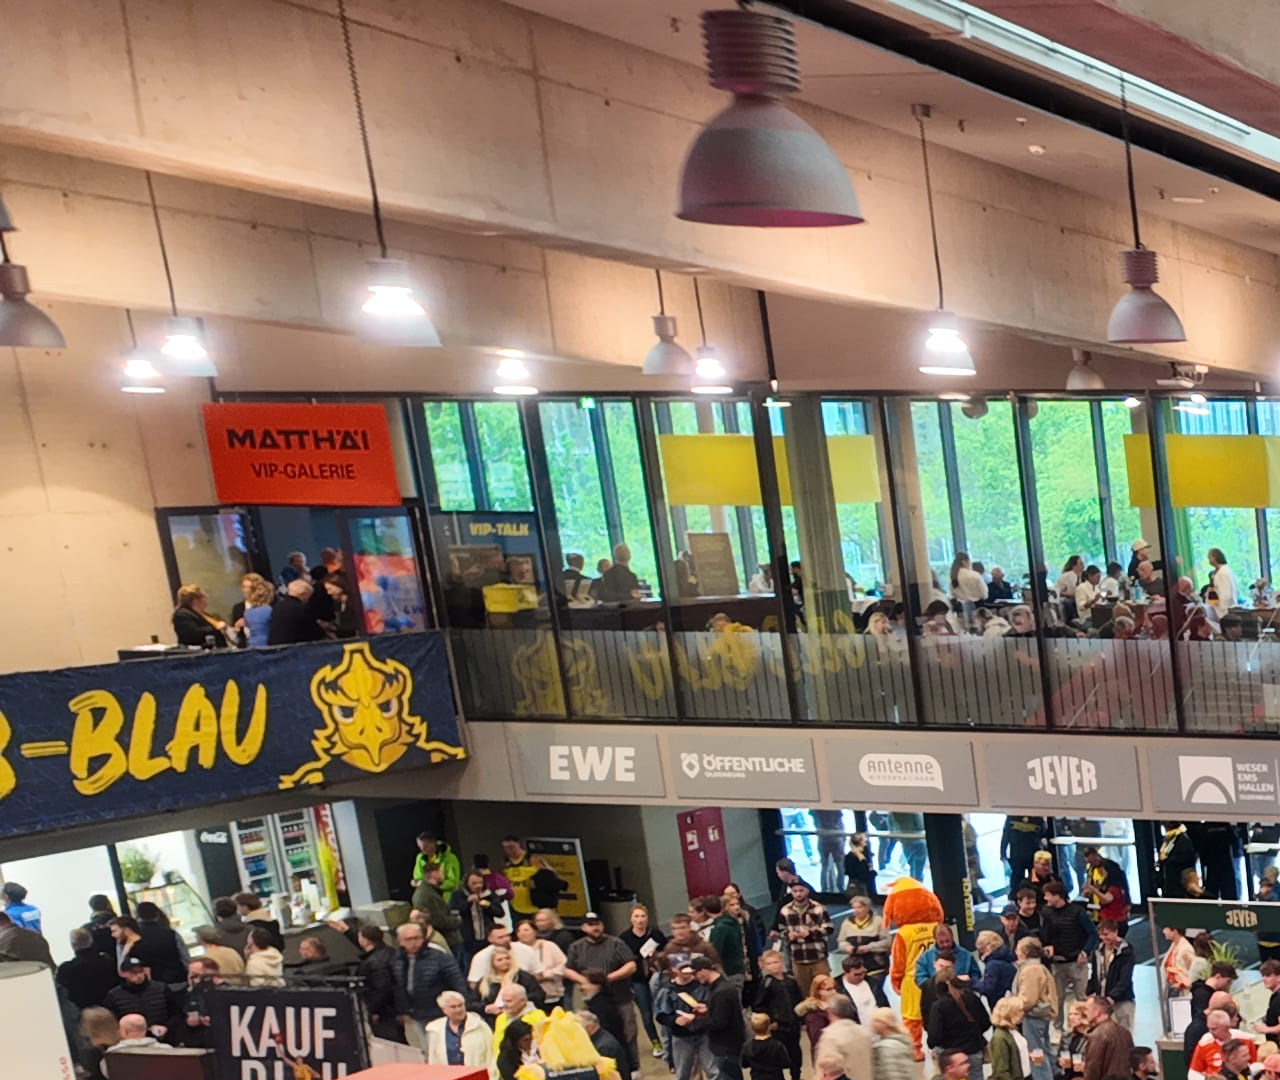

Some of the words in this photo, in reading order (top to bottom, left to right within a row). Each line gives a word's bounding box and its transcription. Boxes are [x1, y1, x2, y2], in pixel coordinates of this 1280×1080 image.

[226, 429, 370, 450] MATTHÄI
[251, 462, 356, 480] VIP-GALERIE
[469, 523, 529, 536] VIP-TALK
[0, 679, 267, 798] -BLAU
[549, 745, 636, 782] EWE
[702, 752, 806, 774] ÖFFENTLICHE
[1236, 763, 1269, 773] WESER
[1027, 755, 1098, 796] JEVER
[1237, 773, 1258, 783] EMS
[1238, 782, 1274, 793] HALLEN
[1226, 910, 1258, 928] JEVER
[230, 1005, 337, 1060] KAUF
